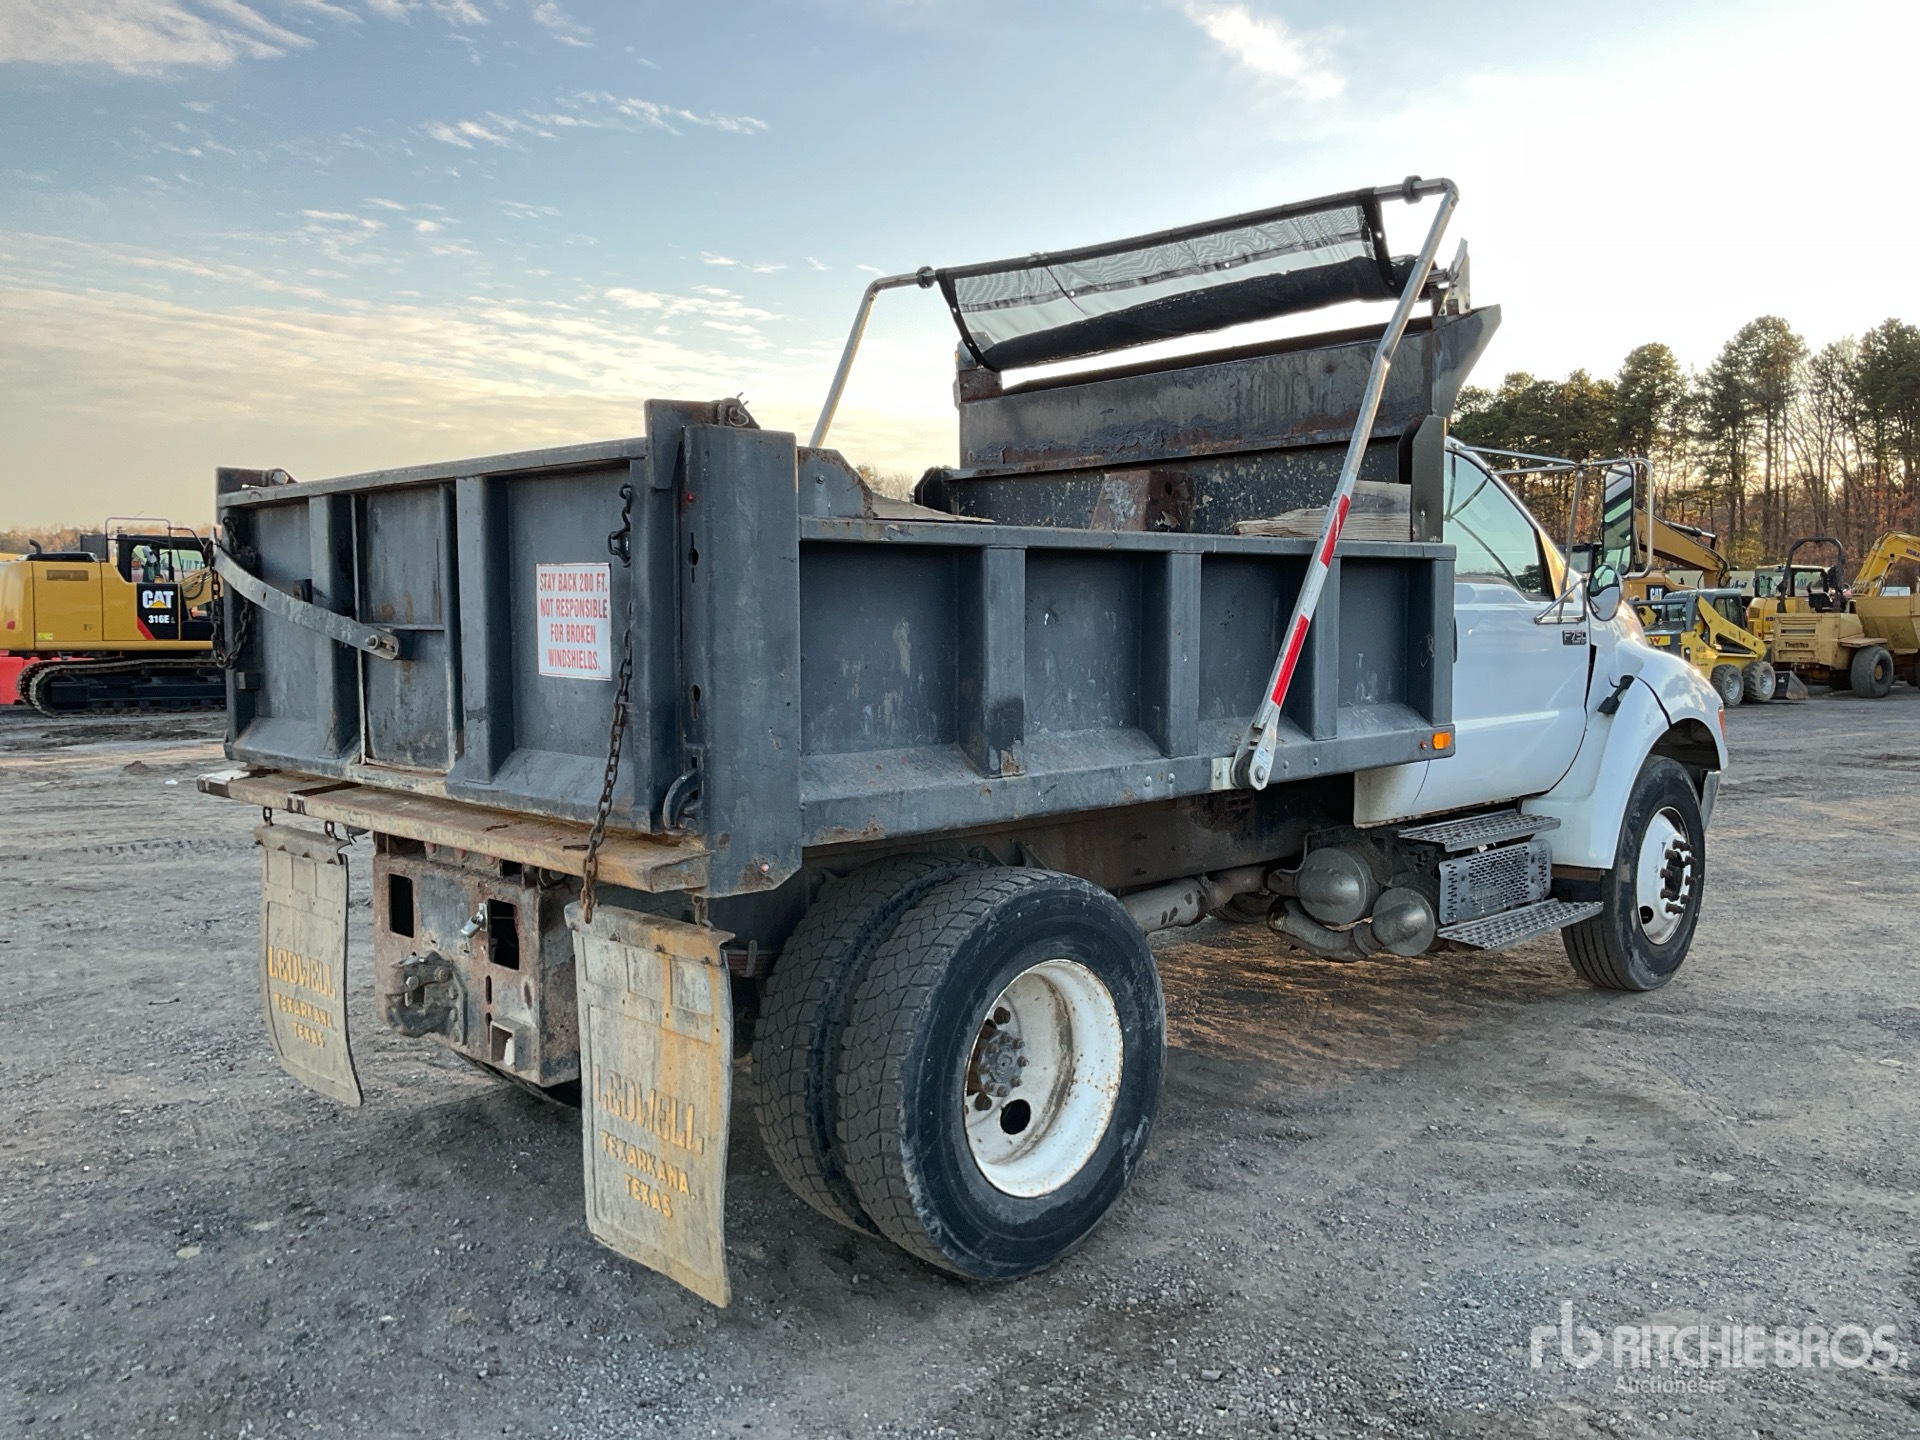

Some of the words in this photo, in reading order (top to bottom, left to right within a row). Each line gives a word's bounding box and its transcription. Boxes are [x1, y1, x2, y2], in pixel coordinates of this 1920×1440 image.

[540, 573, 556, 592] STAY
[558, 573, 578, 592] BACK
[580, 573, 594, 592] 200
[596, 573, 608, 592] FT.
[142, 590, 174, 609] CAT
[1650, 587, 1663, 601] CAT
[540, 598, 554, 616] NOT
[556, 598, 608, 618] RESPONSIBLE
[148, 614, 170, 624] 316E
[550, 624, 564, 642] FOR
[566, 624, 596, 644] BROKEN
[547, 648, 600, 670] WINDSHIELDS.
[266, 945, 337, 1001] LEDWELL
[291, 1021, 326, 1048] TEXAS
[593, 1064, 705, 1156] LEDWELL
[624, 1172, 673, 1218] TEXAS
